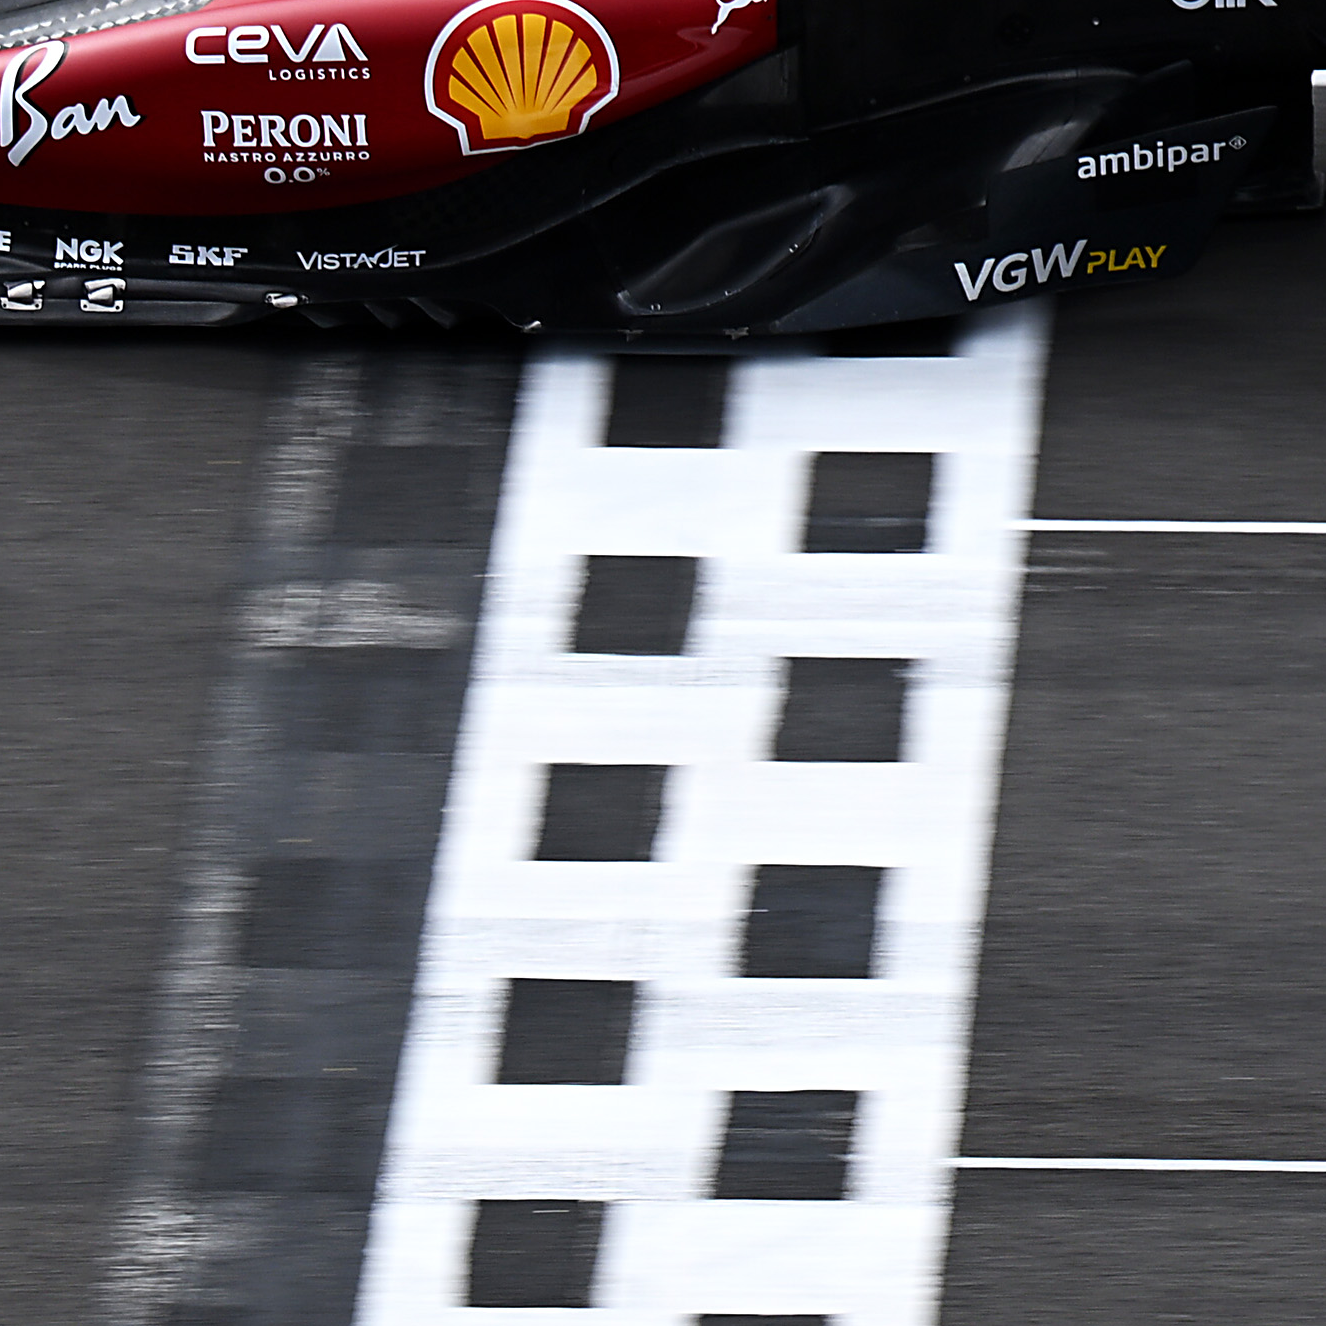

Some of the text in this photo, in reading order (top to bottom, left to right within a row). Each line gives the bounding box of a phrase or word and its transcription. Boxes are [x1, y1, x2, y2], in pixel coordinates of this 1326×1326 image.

[269, 67, 370, 81] LOGISTICS
[201, 110, 369, 148] PERONI
[204, 151, 371, 163] NASTRO AZZURRO
[1077, 141, 1226, 179] ambipar
[264, 167, 331, 185] 0.0%
[55, 237, 124, 265] NGK
[169, 244, 248, 266] SKF
[954, 239, 1167, 301] VGW PLAY
